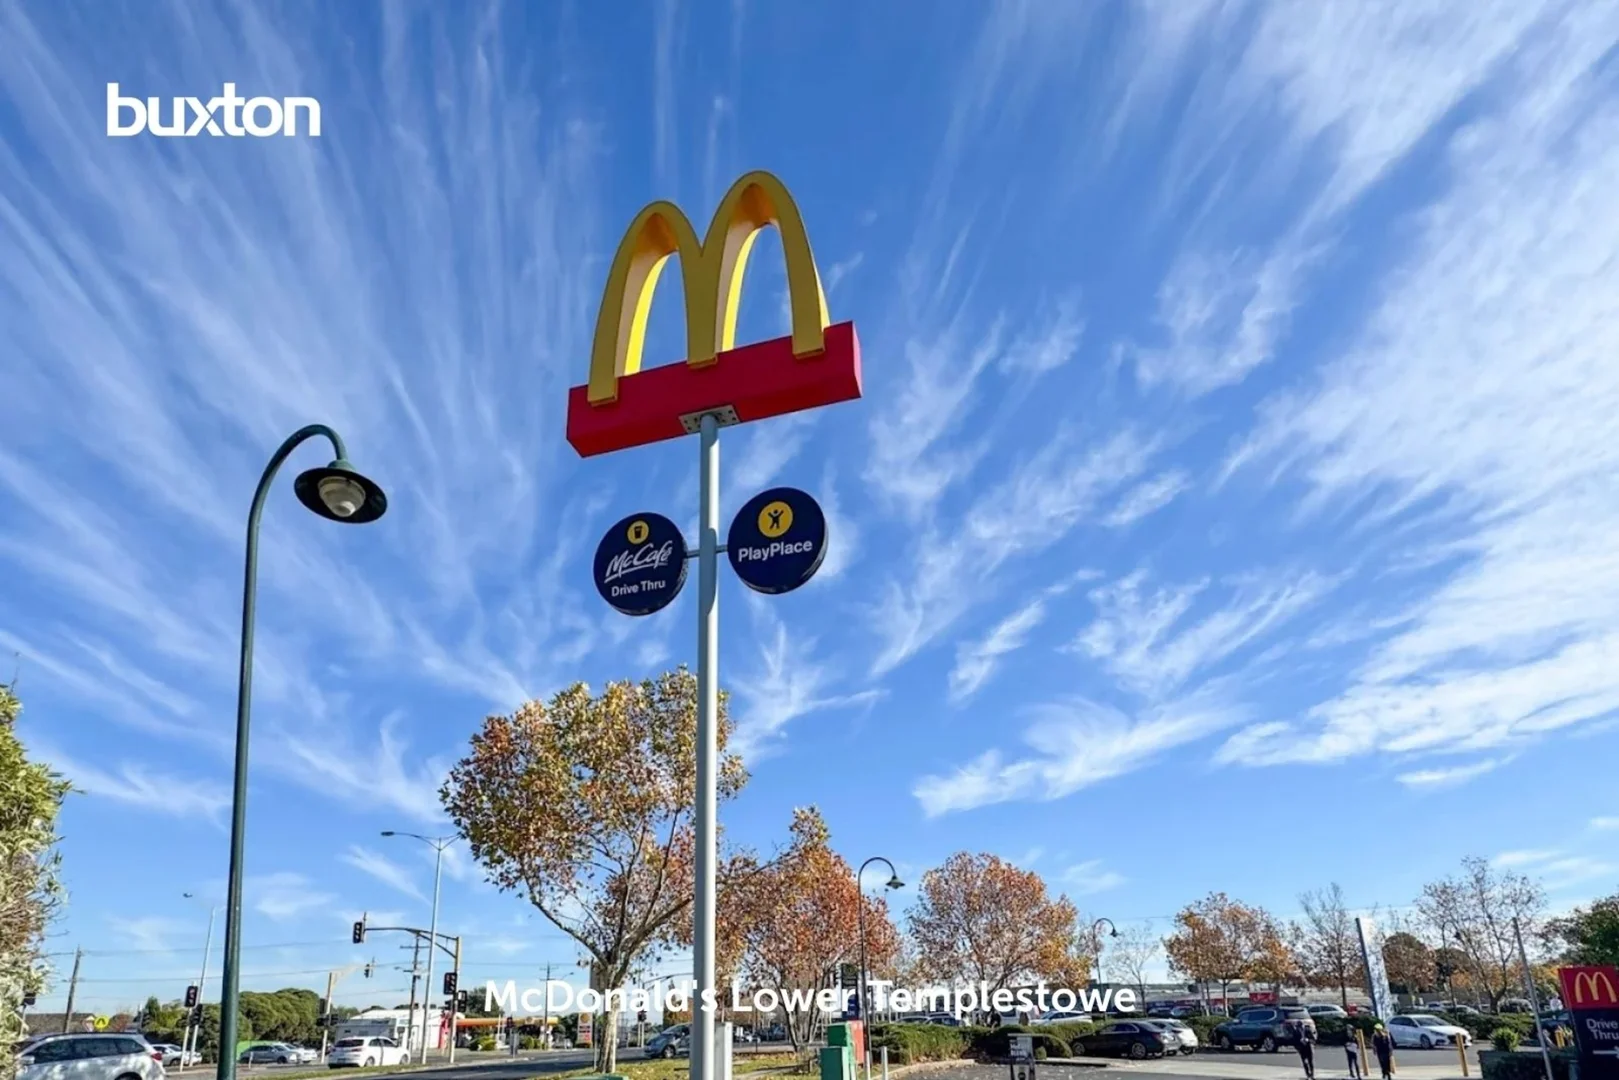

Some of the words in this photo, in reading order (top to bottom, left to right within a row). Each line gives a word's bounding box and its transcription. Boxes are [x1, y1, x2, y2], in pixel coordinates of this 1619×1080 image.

[738, 540, 813, 562] PlayPlace
[611, 584, 639, 598] Drive
[641, 580, 666, 593] Thru
[1586, 1018, 1619, 1029] Drive
